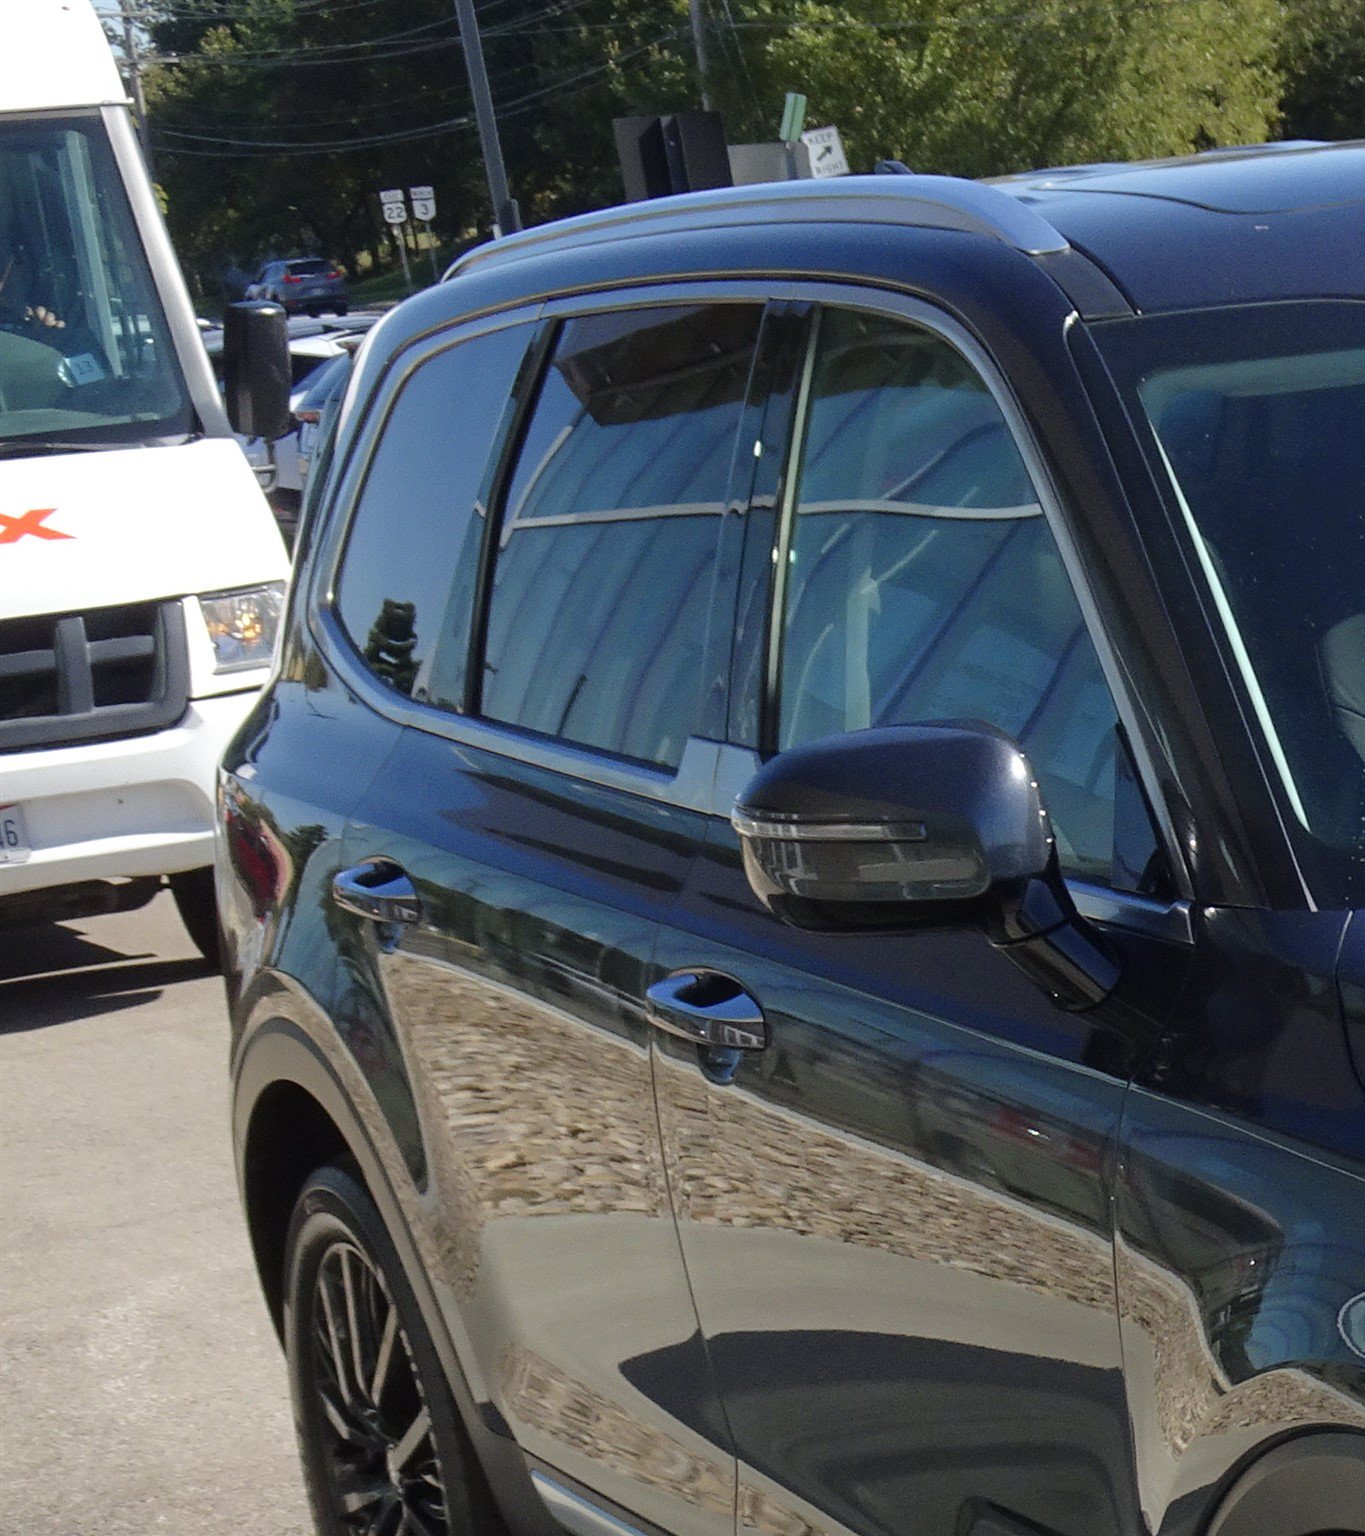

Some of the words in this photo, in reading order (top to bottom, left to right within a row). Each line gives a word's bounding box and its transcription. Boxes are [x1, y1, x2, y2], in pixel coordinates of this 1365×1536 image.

[807, 131, 832, 145] KEEP
[815, 160, 843, 174] RIGHT
[386, 206, 403, 219] 22
[420, 204, 429, 215] 3
